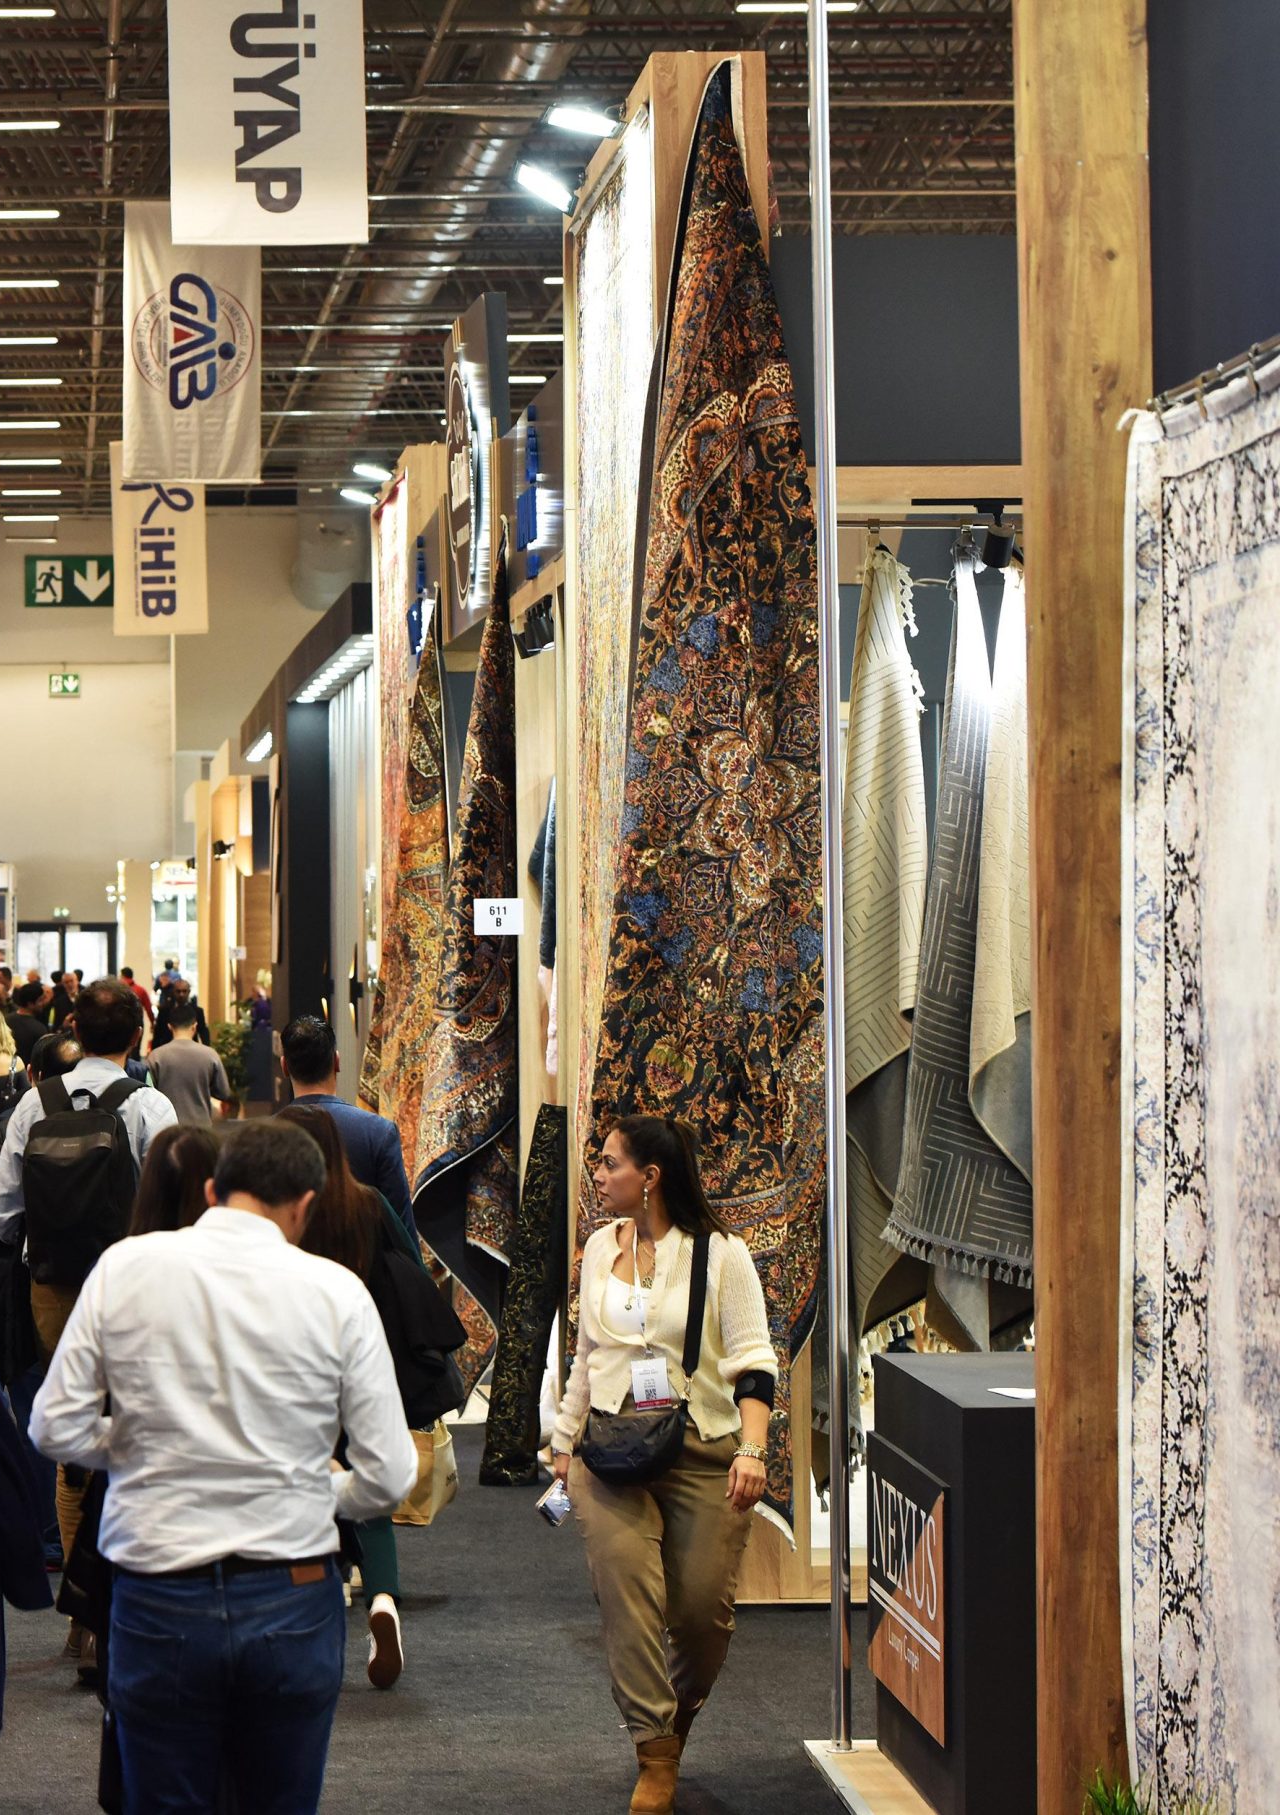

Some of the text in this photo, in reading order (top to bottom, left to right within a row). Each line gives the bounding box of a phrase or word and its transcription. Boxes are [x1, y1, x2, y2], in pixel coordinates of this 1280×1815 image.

[230, 0, 316, 213] ÜYAP
[489, 906, 507, 916] 611
[495, 917, 502, 927] B
[871, 1470, 937, 1621] NEXUS
